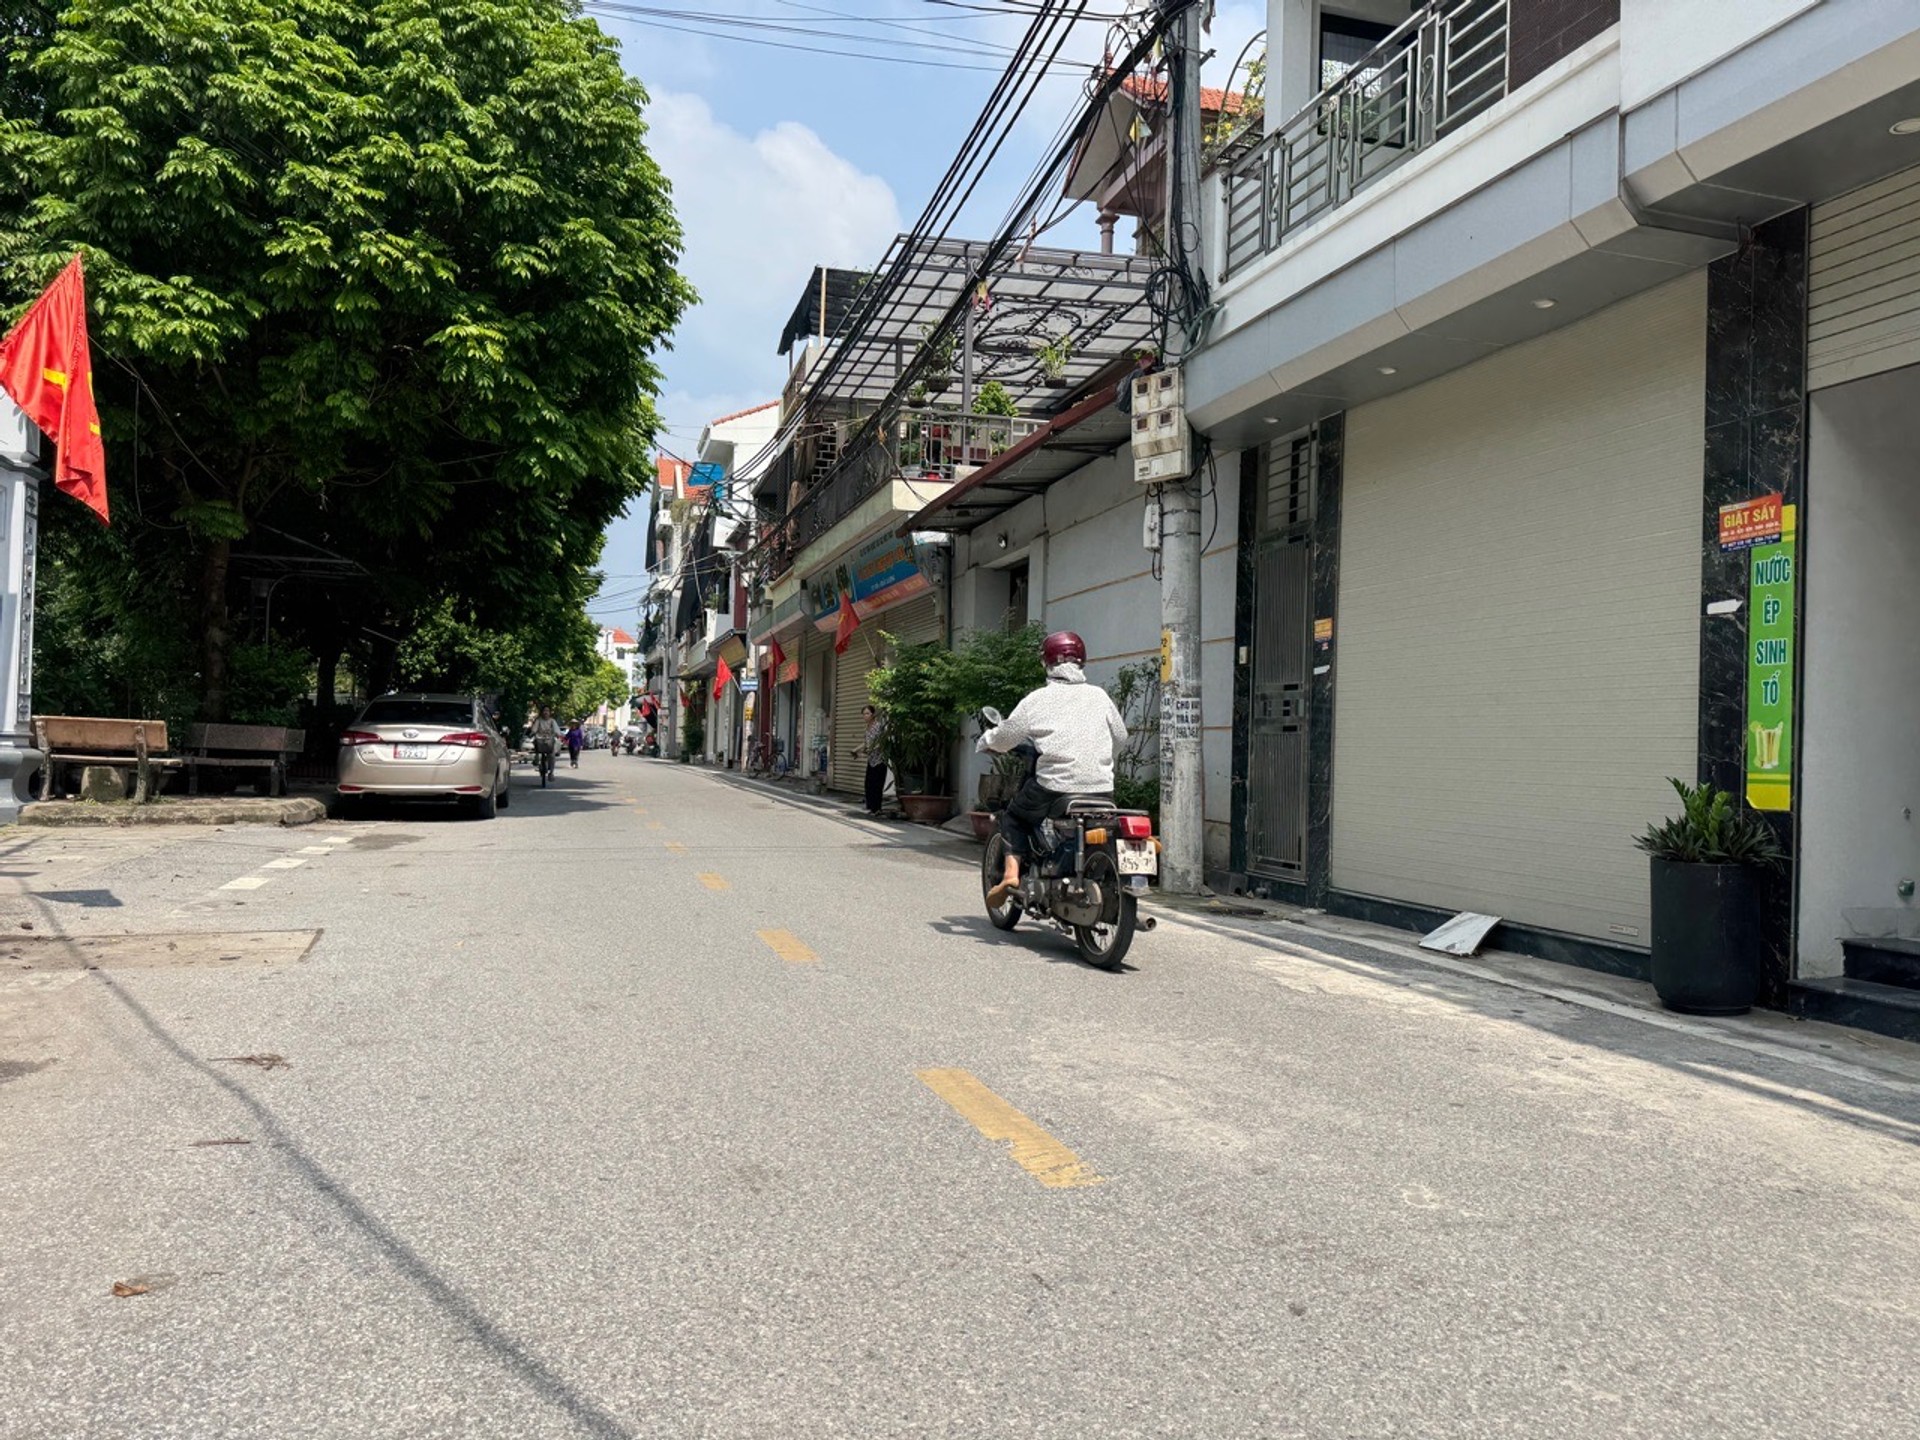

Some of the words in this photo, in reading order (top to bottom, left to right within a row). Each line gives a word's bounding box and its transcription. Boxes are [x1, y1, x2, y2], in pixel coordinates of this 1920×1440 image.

[1755, 551, 1791, 586] NƯỚC
[1763, 594, 1781, 625] ÉP
[1756, 638, 1787, 666] SINH
[1761, 670, 1781, 706] TỐ
